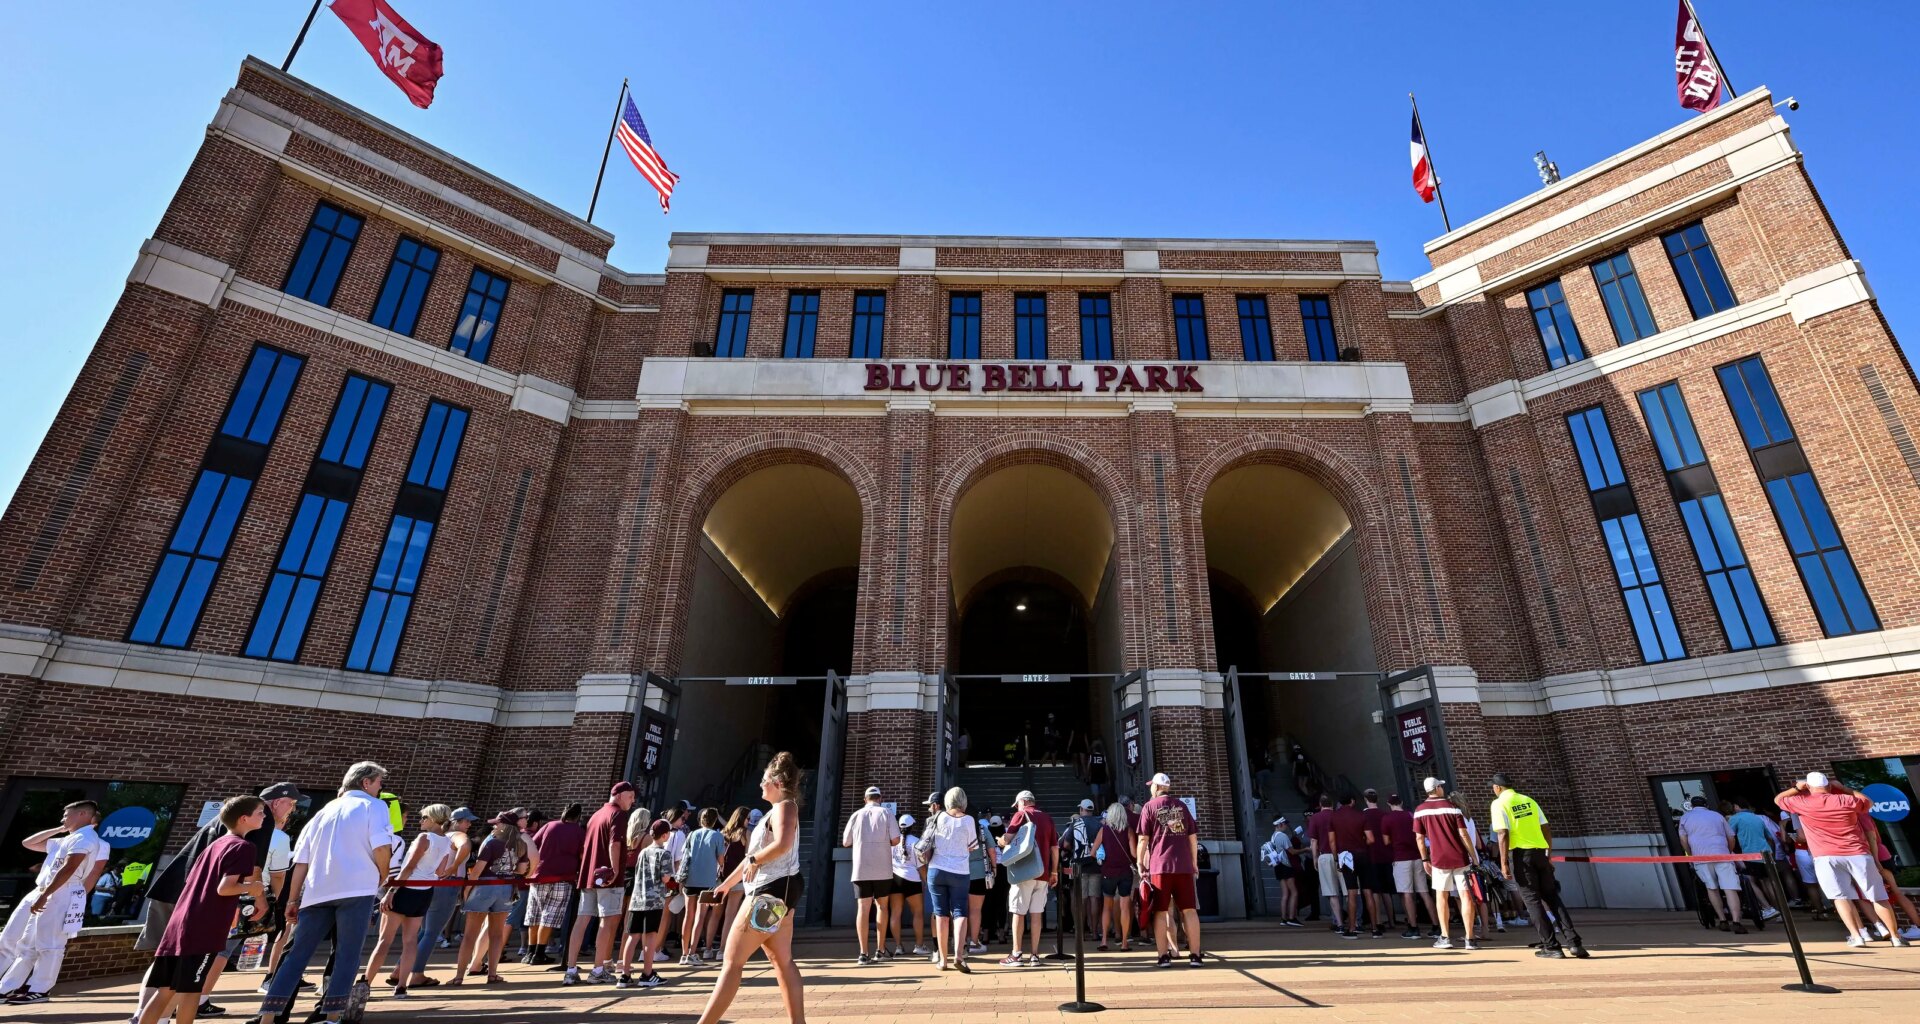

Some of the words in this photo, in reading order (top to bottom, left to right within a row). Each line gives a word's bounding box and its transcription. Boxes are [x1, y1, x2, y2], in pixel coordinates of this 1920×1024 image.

[864, 363, 971, 391] BLUE
[982, 364, 1083, 392] BELL
[1094, 364, 1204, 392] PARK
[748, 676, 769, 685] GATE
[769, 676, 774, 685] 1
[1023, 674, 1042, 682] GATE
[1044, 674, 1049, 682] 2
[1290, 672, 1309, 680] GATE
[1310, 672, 1316, 680] 3
[1403, 716, 1422, 728] PUBLIC
[1402, 725, 1427, 738] ENTRANCE
[1093, 756, 1103, 764] 12
[1512, 802, 1532, 813] BEST
[1868, 800, 1911, 813] NCAA
[101, 825, 152, 839] NCAA
